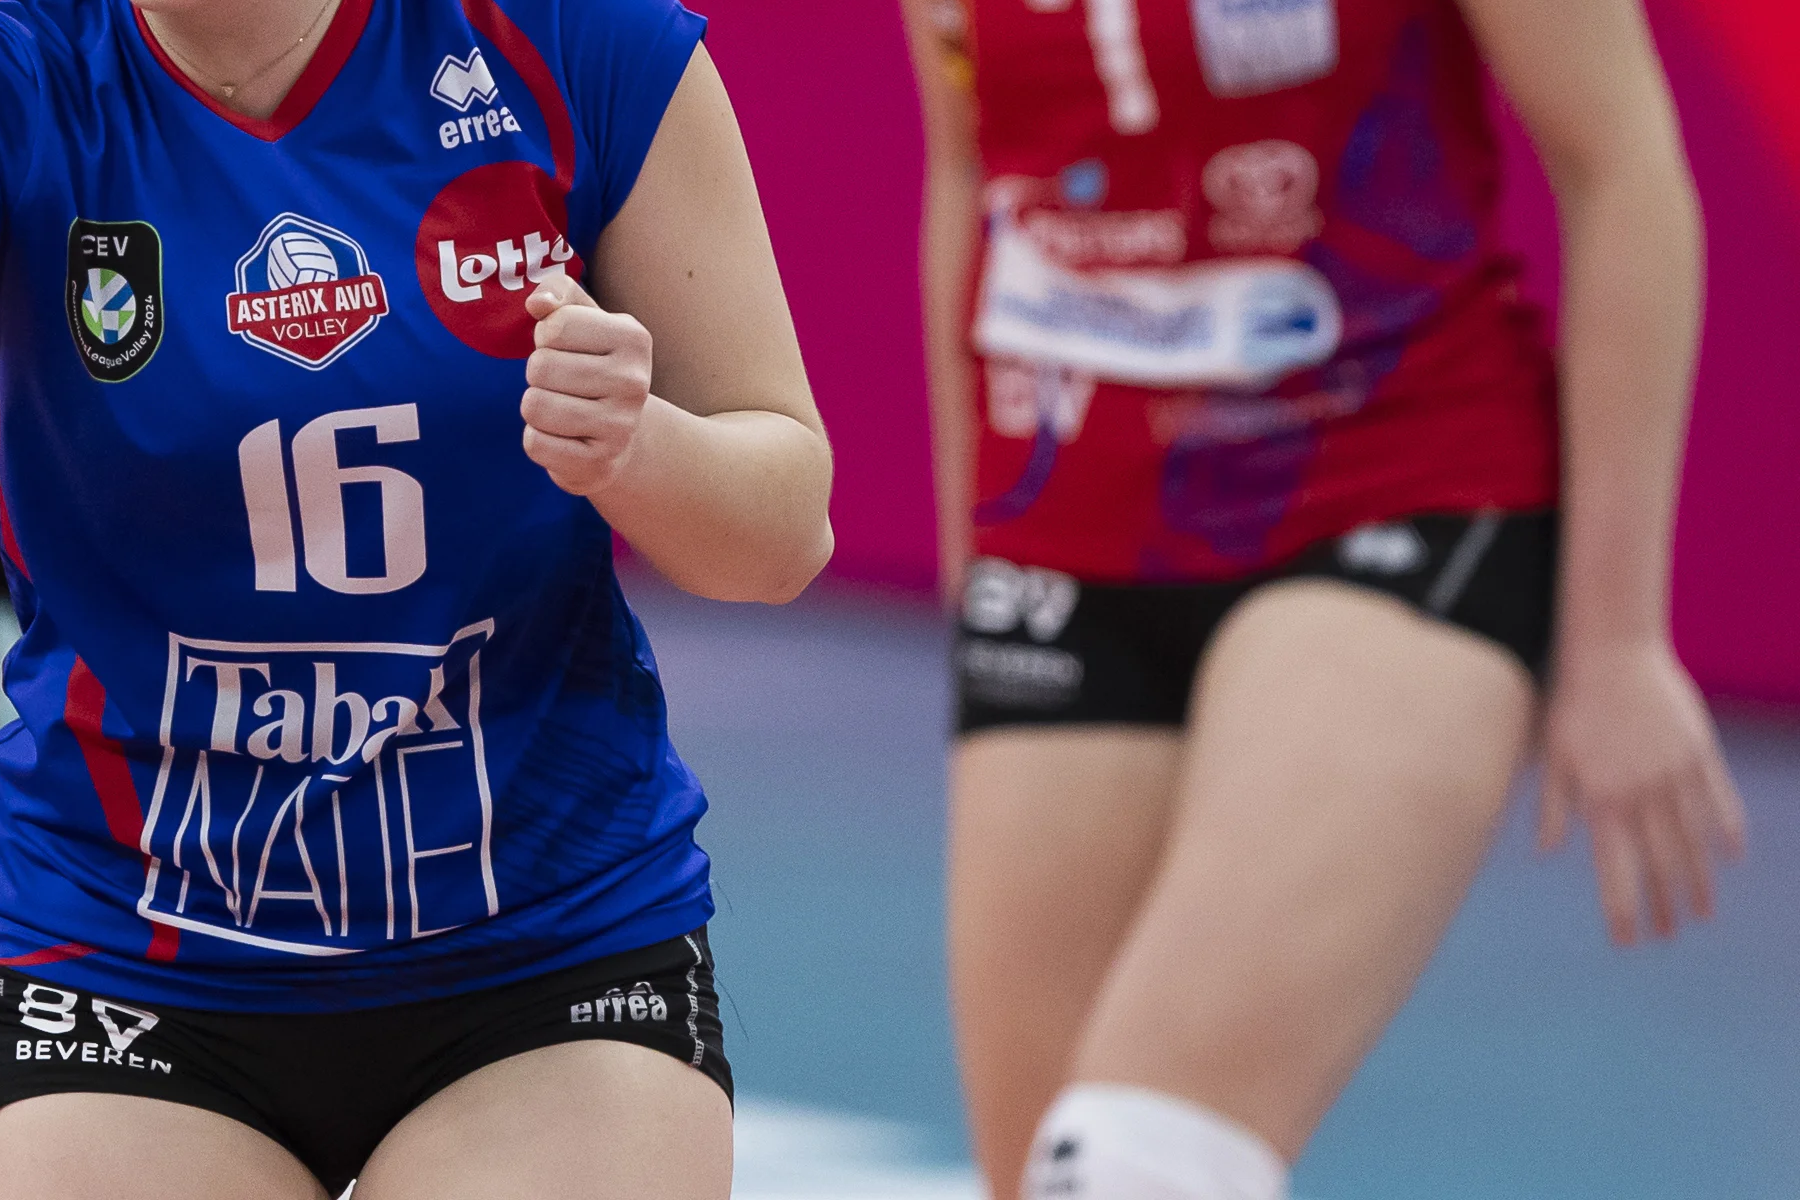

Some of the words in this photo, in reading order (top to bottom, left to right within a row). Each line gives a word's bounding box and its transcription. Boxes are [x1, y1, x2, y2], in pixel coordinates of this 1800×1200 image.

[80, 234, 129, 257] CEV
[144, 294, 155, 329] 2024
[237, 287, 328, 324] ASTERIX
[335, 281, 378, 312] AVO
[271, 318, 348, 341] VOLLEY
[238, 403, 427, 595] 16
[15, 1039, 172, 1074] BEVEREN
